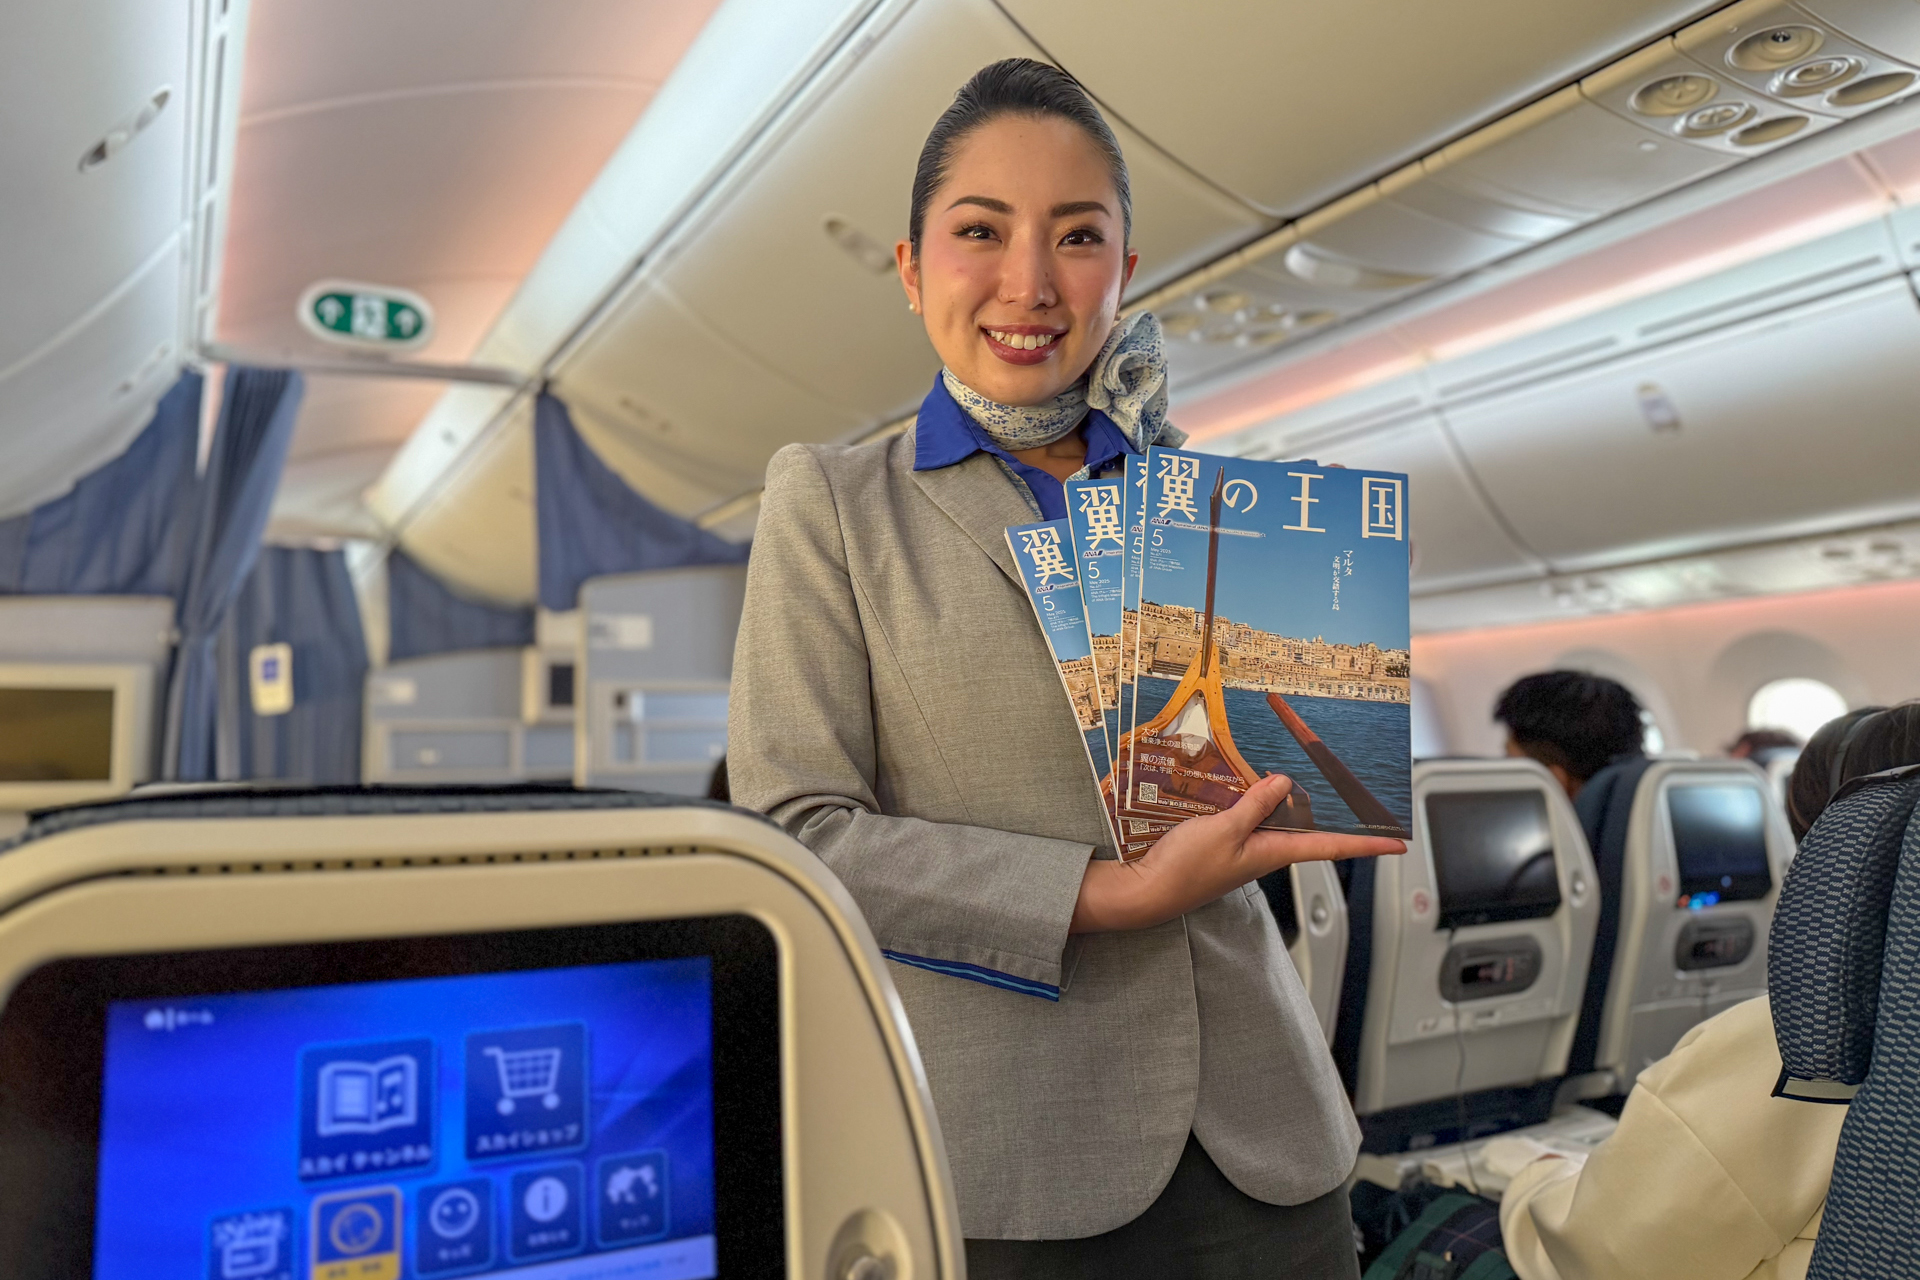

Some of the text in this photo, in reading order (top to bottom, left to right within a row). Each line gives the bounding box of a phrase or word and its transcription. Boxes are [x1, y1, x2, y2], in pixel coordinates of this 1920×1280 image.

[1156, 454, 1402, 541] 翼の王国
[1077, 485, 1124, 550] 翼
[1151, 528, 1163, 546] 5
[1018, 527, 1074, 585] 翼
[1342, 550, 1354, 577] マルタ
[1088, 561, 1100, 579] 5
[1043, 596, 1055, 612] 5
[1141, 727, 1159, 737] 大分
